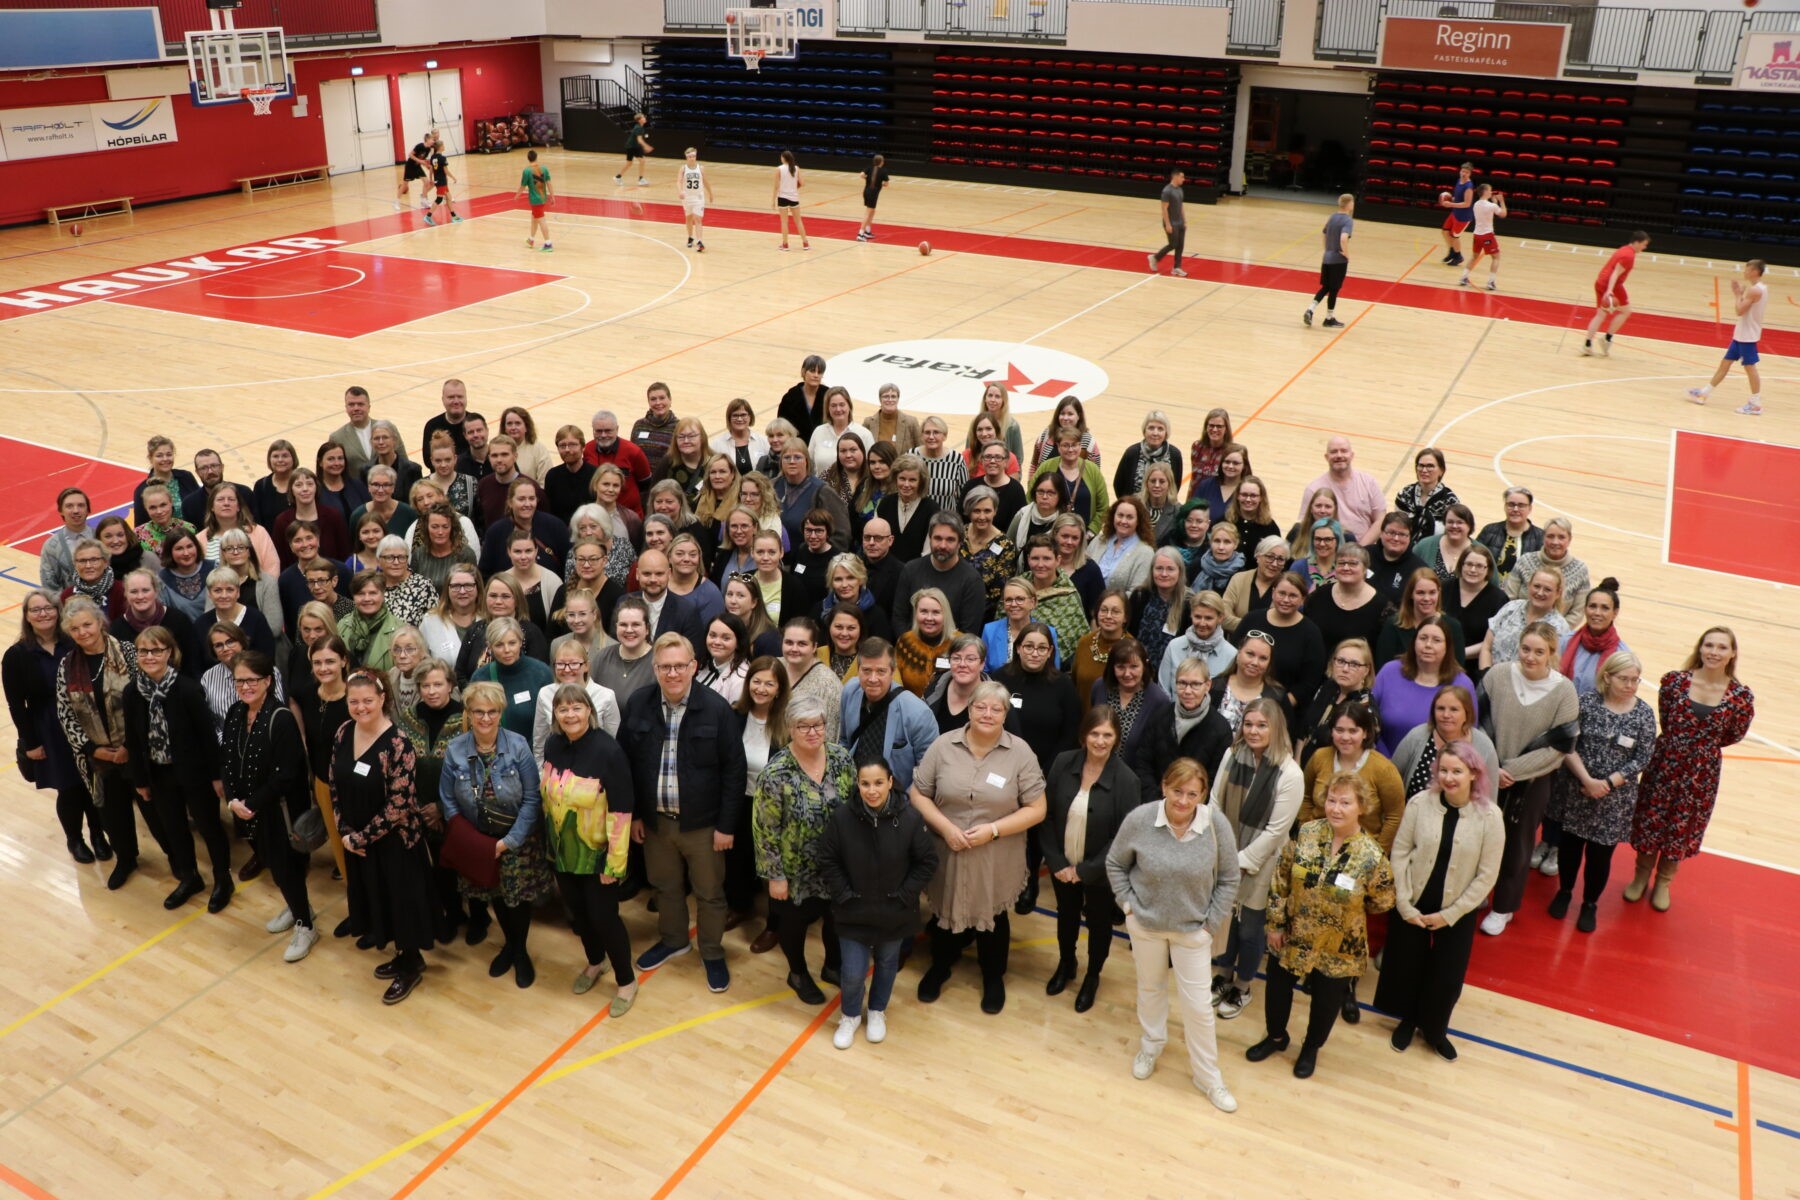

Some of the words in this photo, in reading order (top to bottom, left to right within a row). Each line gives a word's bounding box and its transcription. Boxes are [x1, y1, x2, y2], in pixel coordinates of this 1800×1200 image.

[1436, 24, 1511, 53] Reginn
[1433, 54, 1508, 66] FASTEIGNAFÉLAG
[1744, 66, 1800, 81] KASTA
[107, 132, 168, 148] HÓPBÍLAR
[686, 180, 700, 190] 33
[0, 235, 348, 310] HAUKAR
